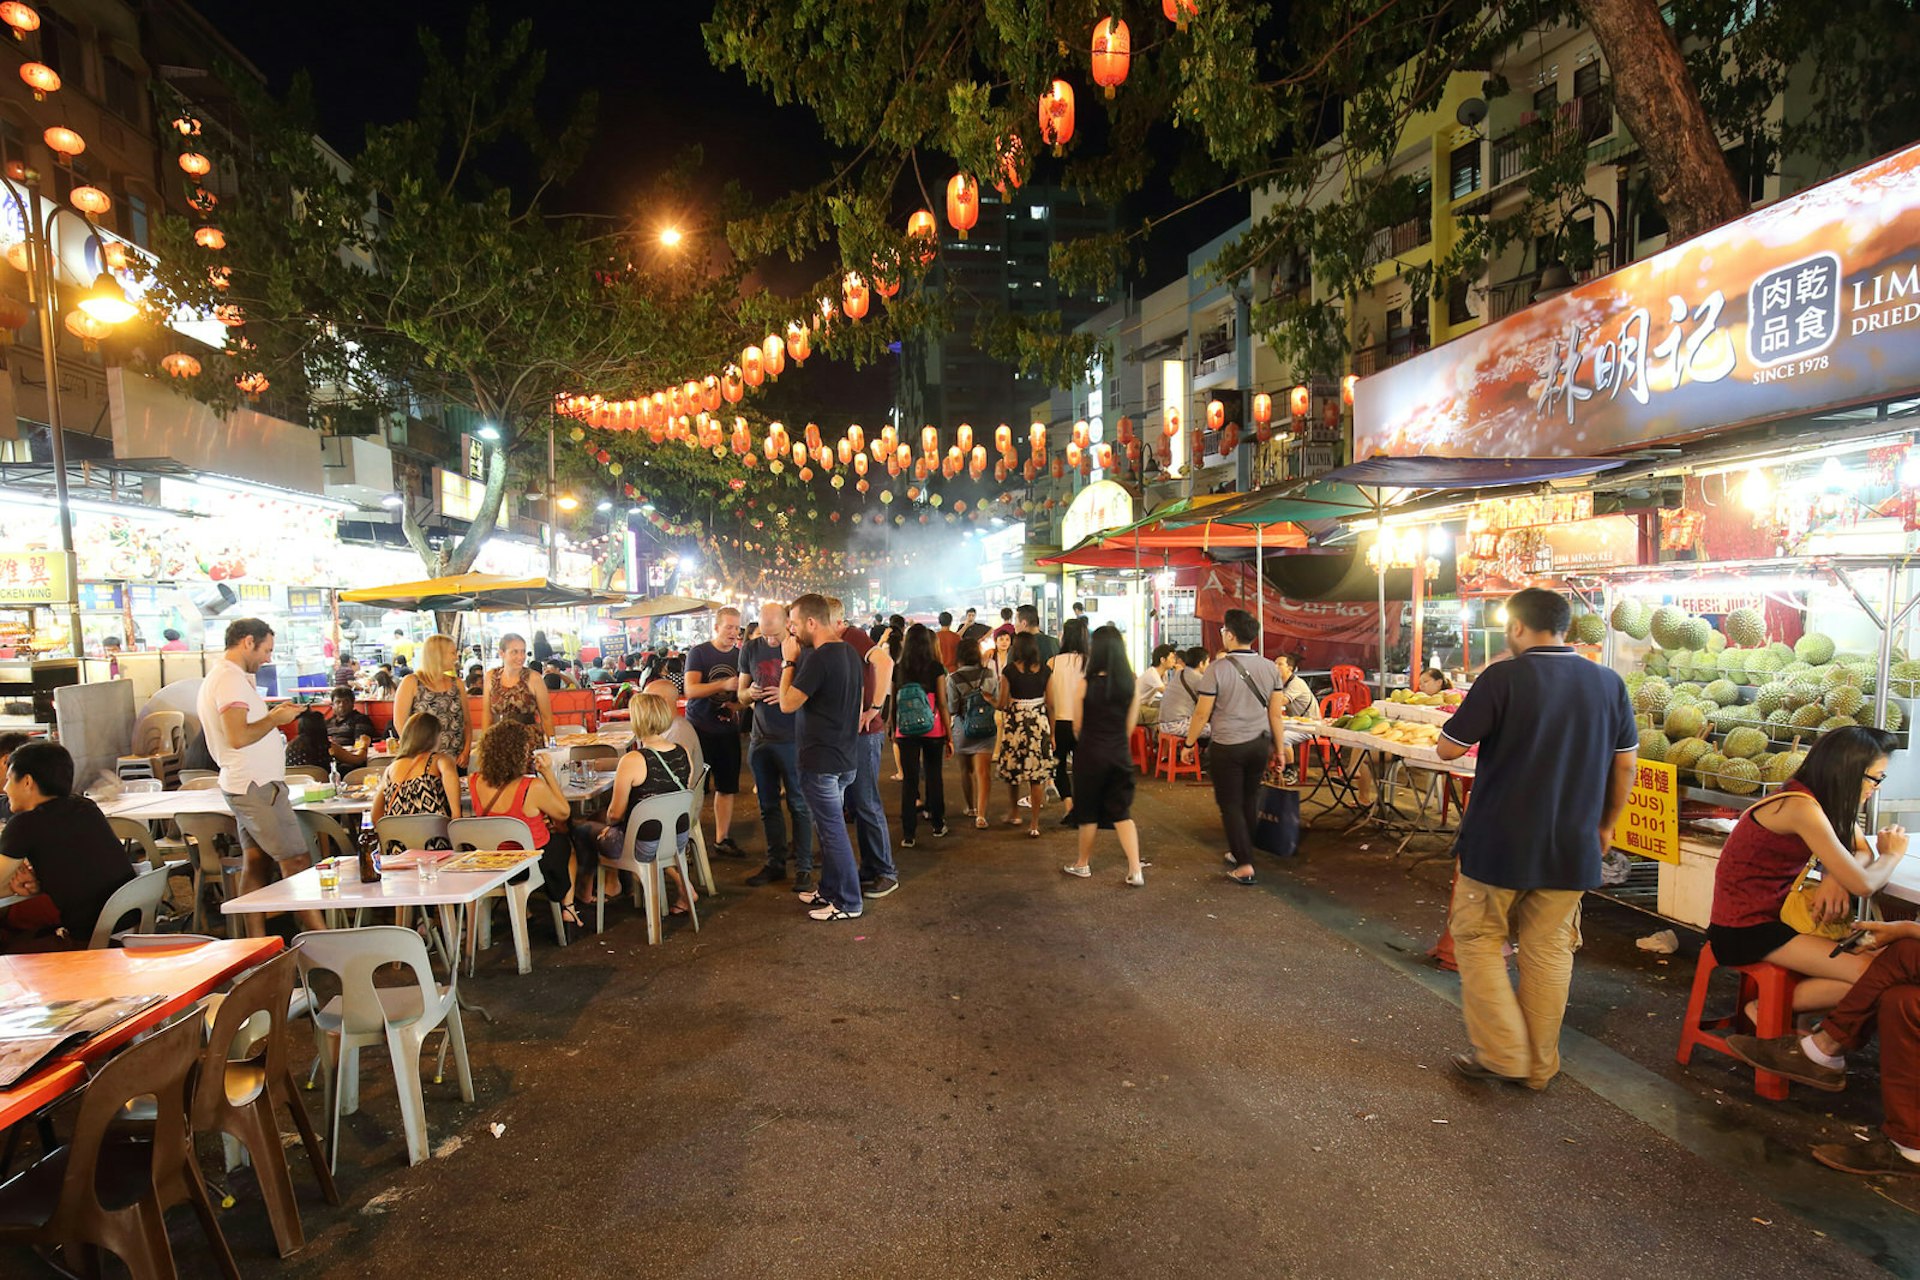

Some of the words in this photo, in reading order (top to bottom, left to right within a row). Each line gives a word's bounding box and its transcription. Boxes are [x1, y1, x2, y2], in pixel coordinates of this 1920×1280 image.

[1852, 264, 1920, 312] LIM
[1851, 302, 1920, 336] DRIED
[1752, 364, 1795, 385] SINCE
[1798, 355, 1830, 375] 1978
[1571, 552, 1597, 562] MENG
[27, 587, 52, 598] WING
[1682, 598, 1720, 613] FRESH
[1630, 811, 1666, 834] D101
[1626, 830, 1668, 856] 貓山王
